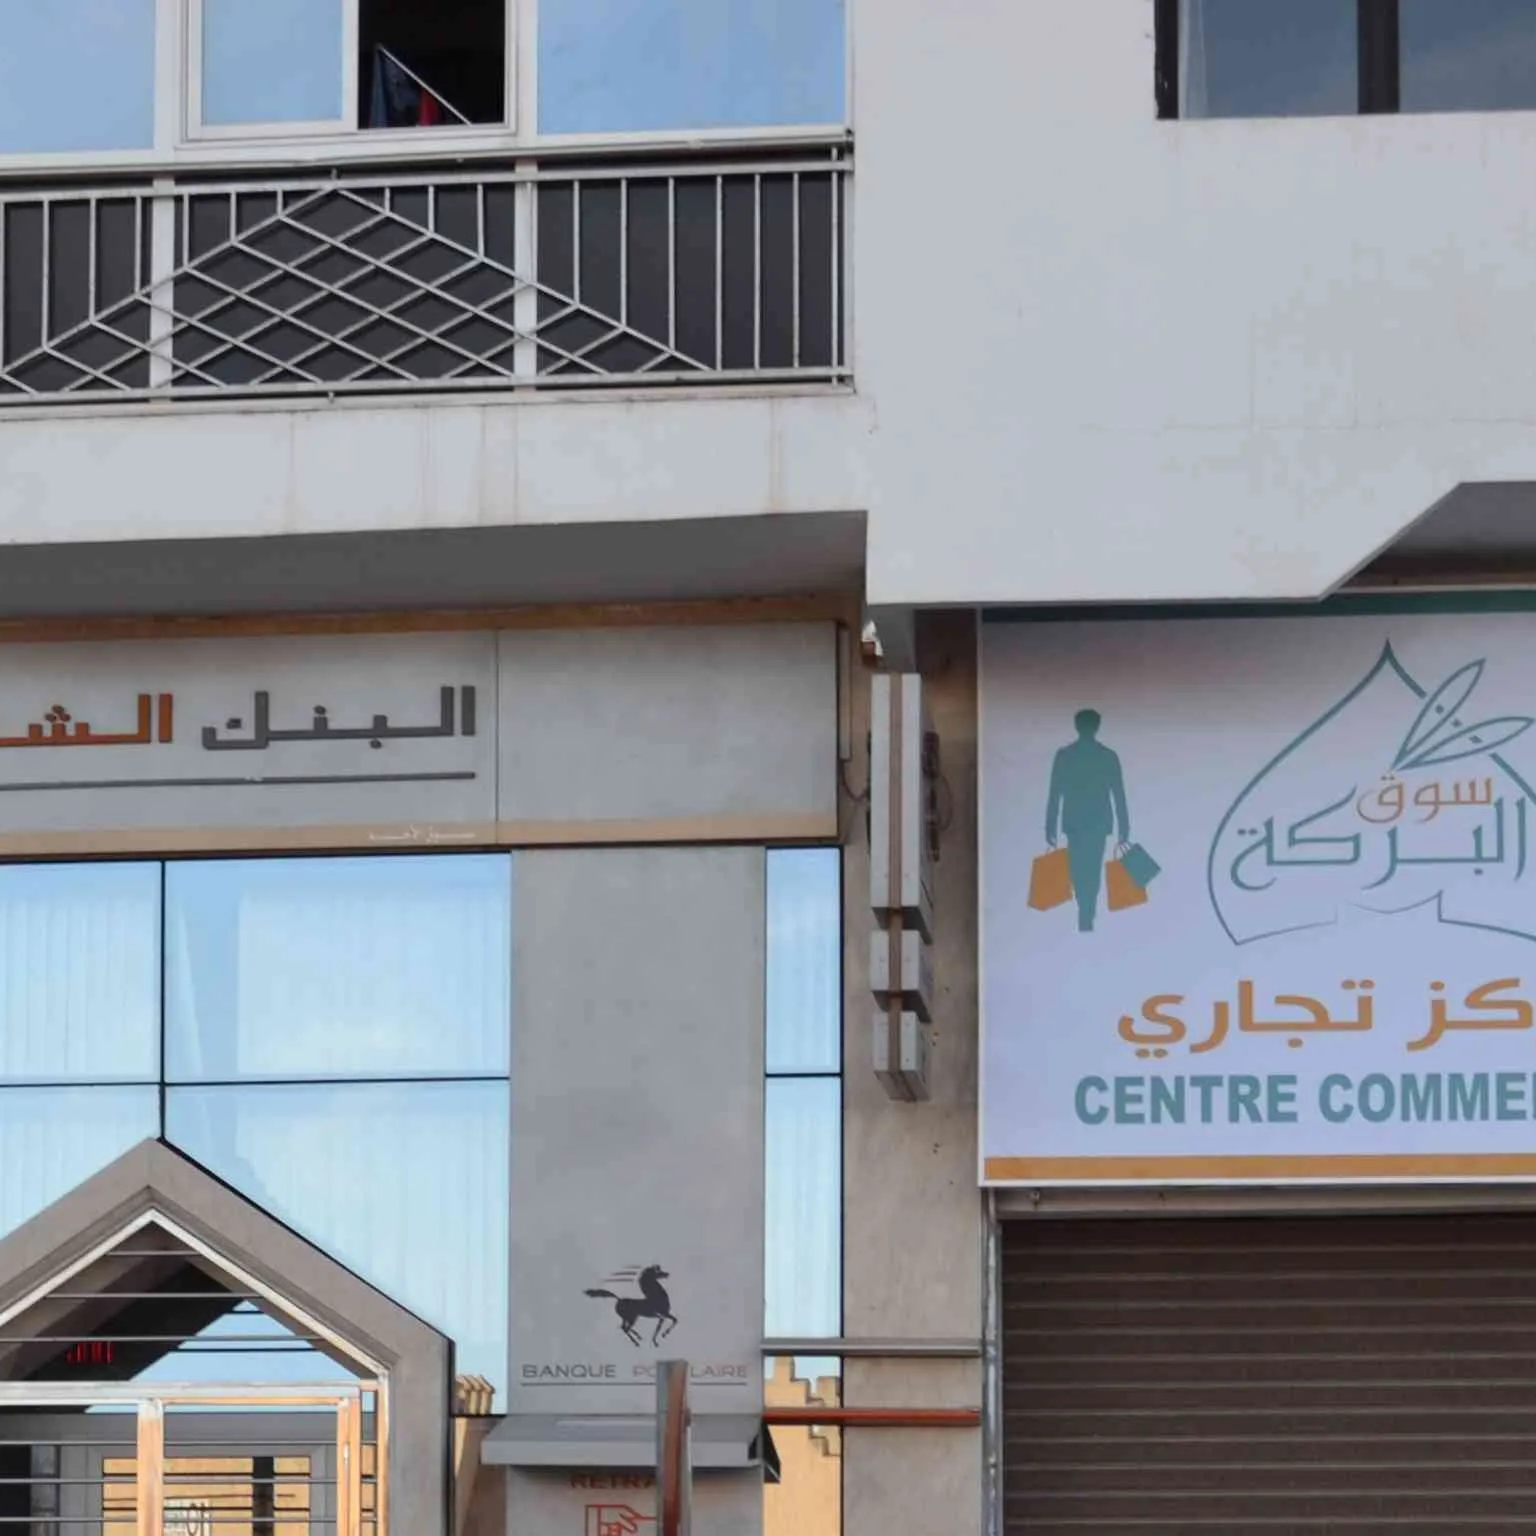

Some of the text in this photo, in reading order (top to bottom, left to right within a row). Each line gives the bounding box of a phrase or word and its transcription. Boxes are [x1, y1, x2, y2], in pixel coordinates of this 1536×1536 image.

[201, 685, 477, 752] البنك
[1355, 773, 1493, 825] سوق
[1230, 786, 1527, 892] البركة
[1116, 979, 1375, 1059] تجاري
[1074, 1074, 1298, 1126] CENTRE
[521, 1363, 748, 1379] BANQUE POLAIRE
[569, 1474, 656, 1489] RETRA
